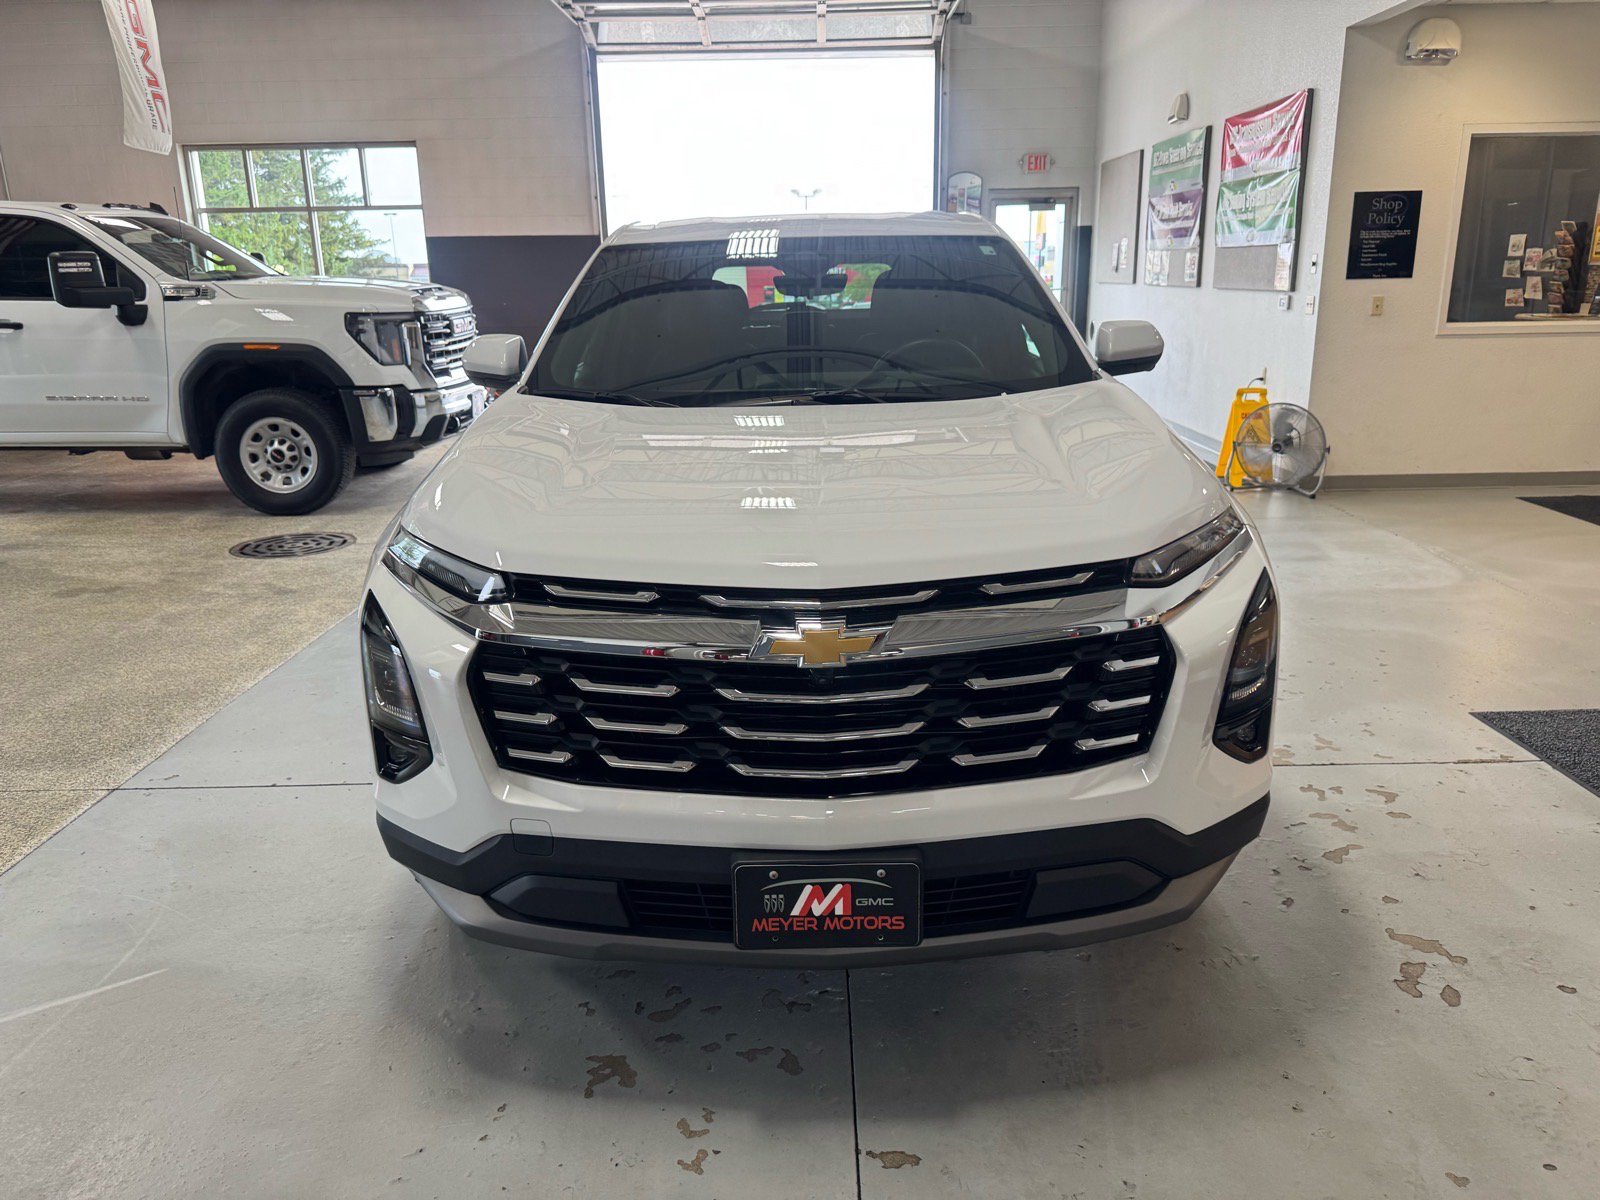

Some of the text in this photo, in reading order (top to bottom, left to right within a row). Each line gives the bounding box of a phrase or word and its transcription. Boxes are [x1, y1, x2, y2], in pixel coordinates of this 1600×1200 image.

[124, 0, 171, 134] GMC
[1027, 154, 1048, 171] EXIT
[1372, 198, 1403, 213] Shop
[1367, 212, 1405, 227] Policy
[855, 897, 894, 906] GMC
[752, 916, 905, 932] MEYER MOTORS
